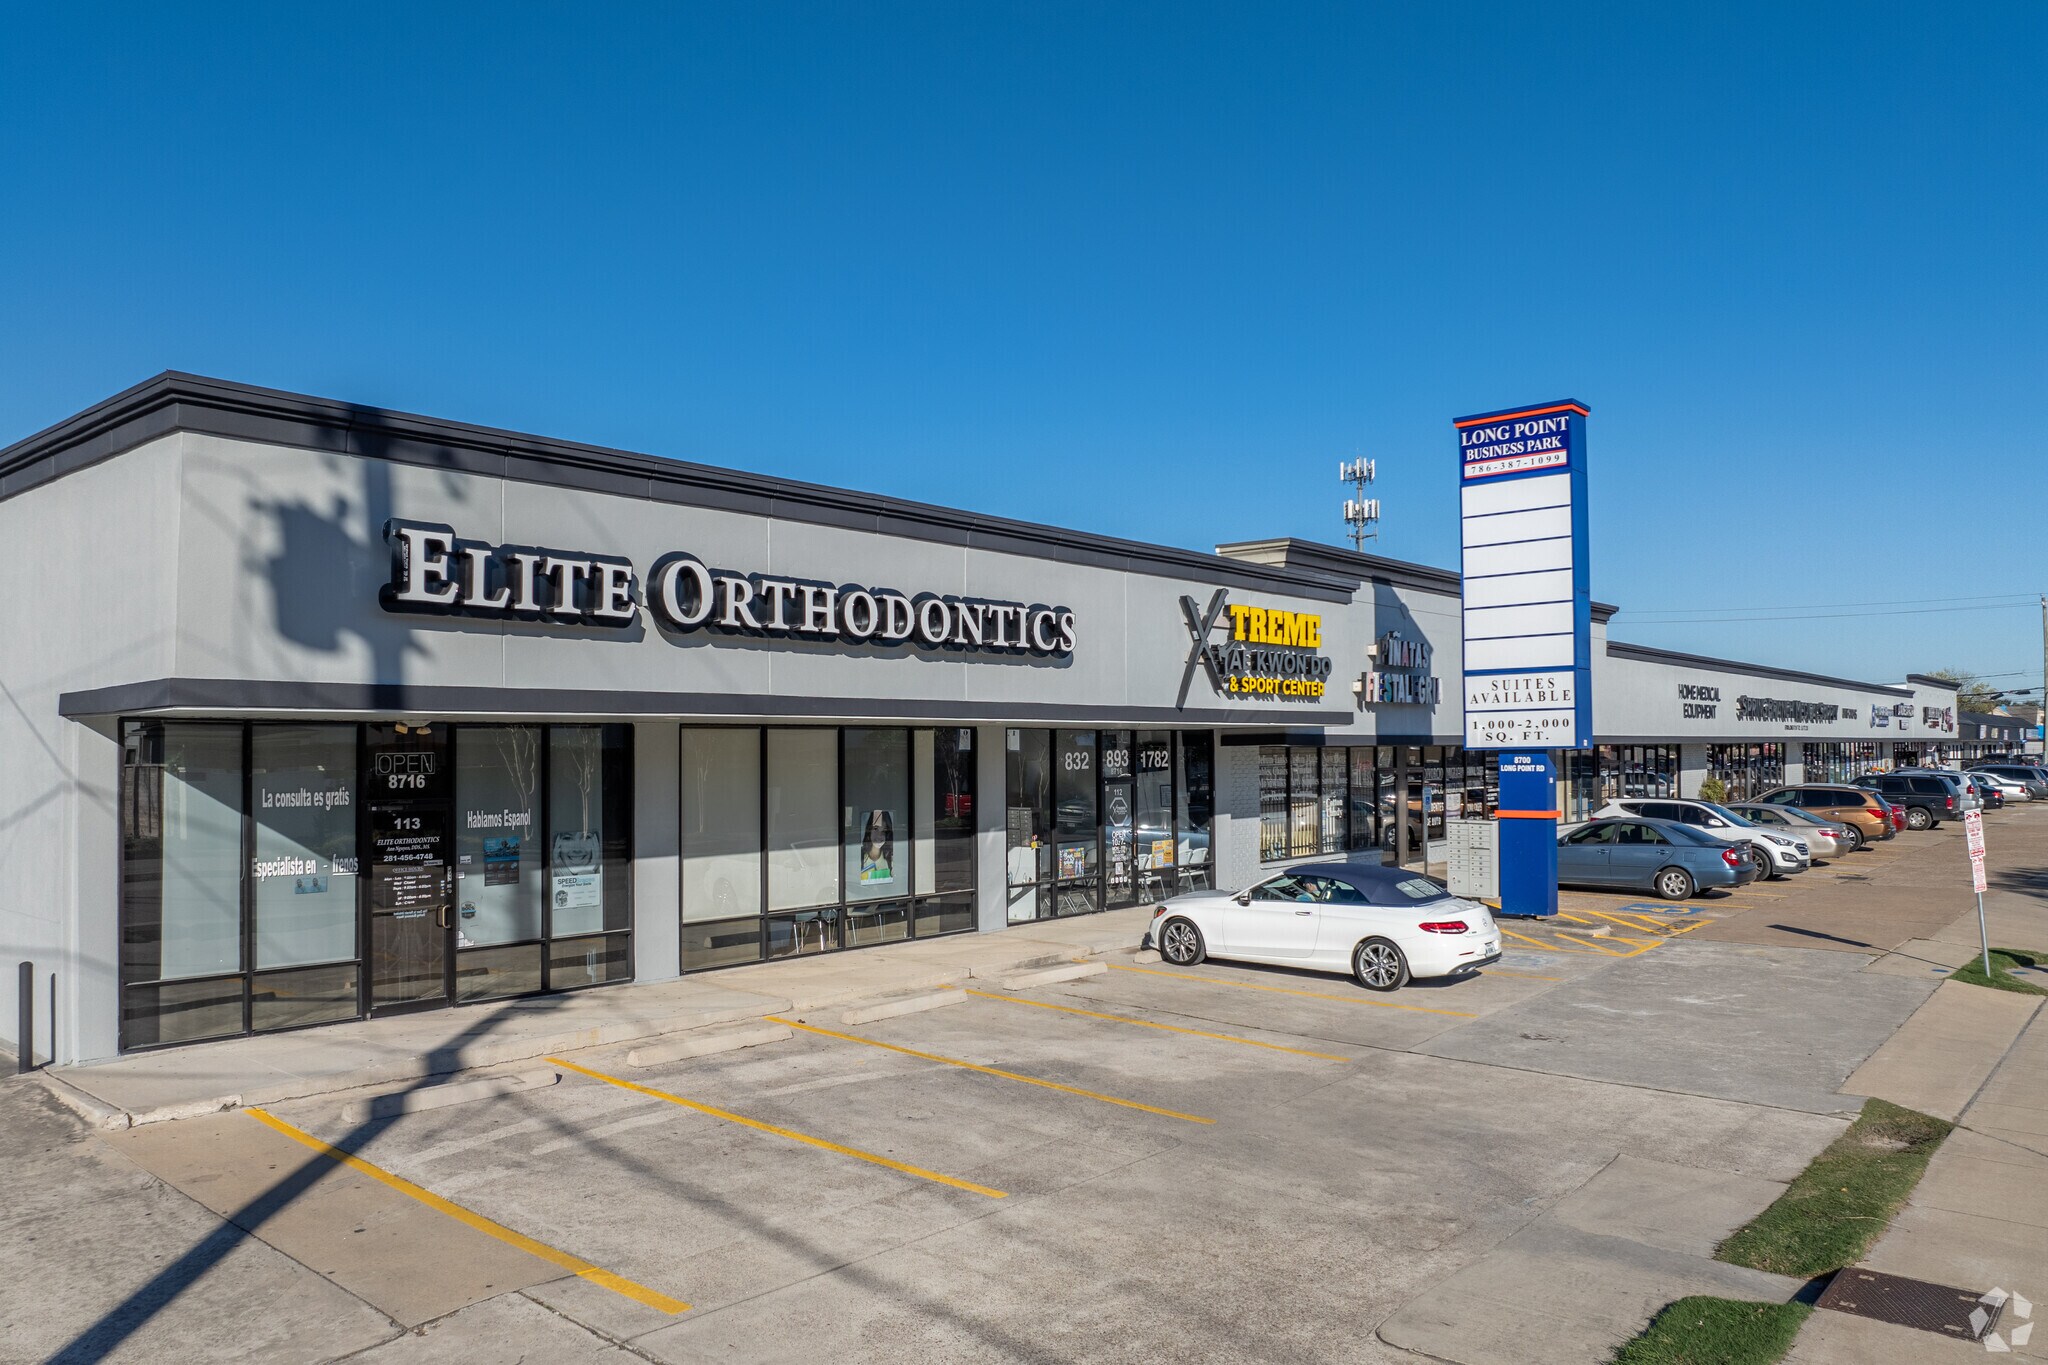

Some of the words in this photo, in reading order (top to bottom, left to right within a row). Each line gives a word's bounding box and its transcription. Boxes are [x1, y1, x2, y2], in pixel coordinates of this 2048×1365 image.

[1461, 425, 1510, 446] LONG
[1514, 416, 1569, 439] POINT
[1466, 441, 1524, 461] BUSINESS
[1527, 436, 1562, 452] PARK
[1471, 455, 1560, 474] 786-387-1099
[397, 528, 636, 619] ELITE
[662, 559, 1077, 652] ORTHODONTICS
[1256, 649, 1307, 674] KWON
[1310, 655, 1332, 676] DO
[1229, 676, 1239, 693] &
[1241, 677, 1280, 694] SPORT
[1282, 680, 1325, 697] CENTER
[1491, 678, 1555, 691] SUITES
[1470, 690, 1571, 704] AVAILABLE
[1473, 718, 1569, 730] 1,000-2,000
[1485, 732, 1513, 743] SQ.
[1523, 731, 1549, 741] FT.
[378, 755, 433, 773] OPEN
[1065, 752, 1089, 770] 832
[1106, 750, 1129, 767] 893
[1140, 750, 1169, 768] 1782
[1514, 756, 1531, 764] 8700
[388, 774, 426, 788] 8716
[262, 788, 273, 808] La
[275, 788, 311, 807] consulta
[313, 791, 323, 806] es
[325, 786, 350, 811] gratis
[1114, 788, 1122, 796] 112
[394, 817, 421, 829] 113
[467, 810, 502, 828] Hablamos
[503, 808, 531, 831] Espanol
[377, 838, 394, 846] ELITE
[394, 836, 440, 845] ORTHODONTICS
[383, 853, 434, 862] 281-456-4748
[252, 856, 304, 882] Especialista
[305, 859, 317, 874] en
[332, 854, 359, 873] frenos
